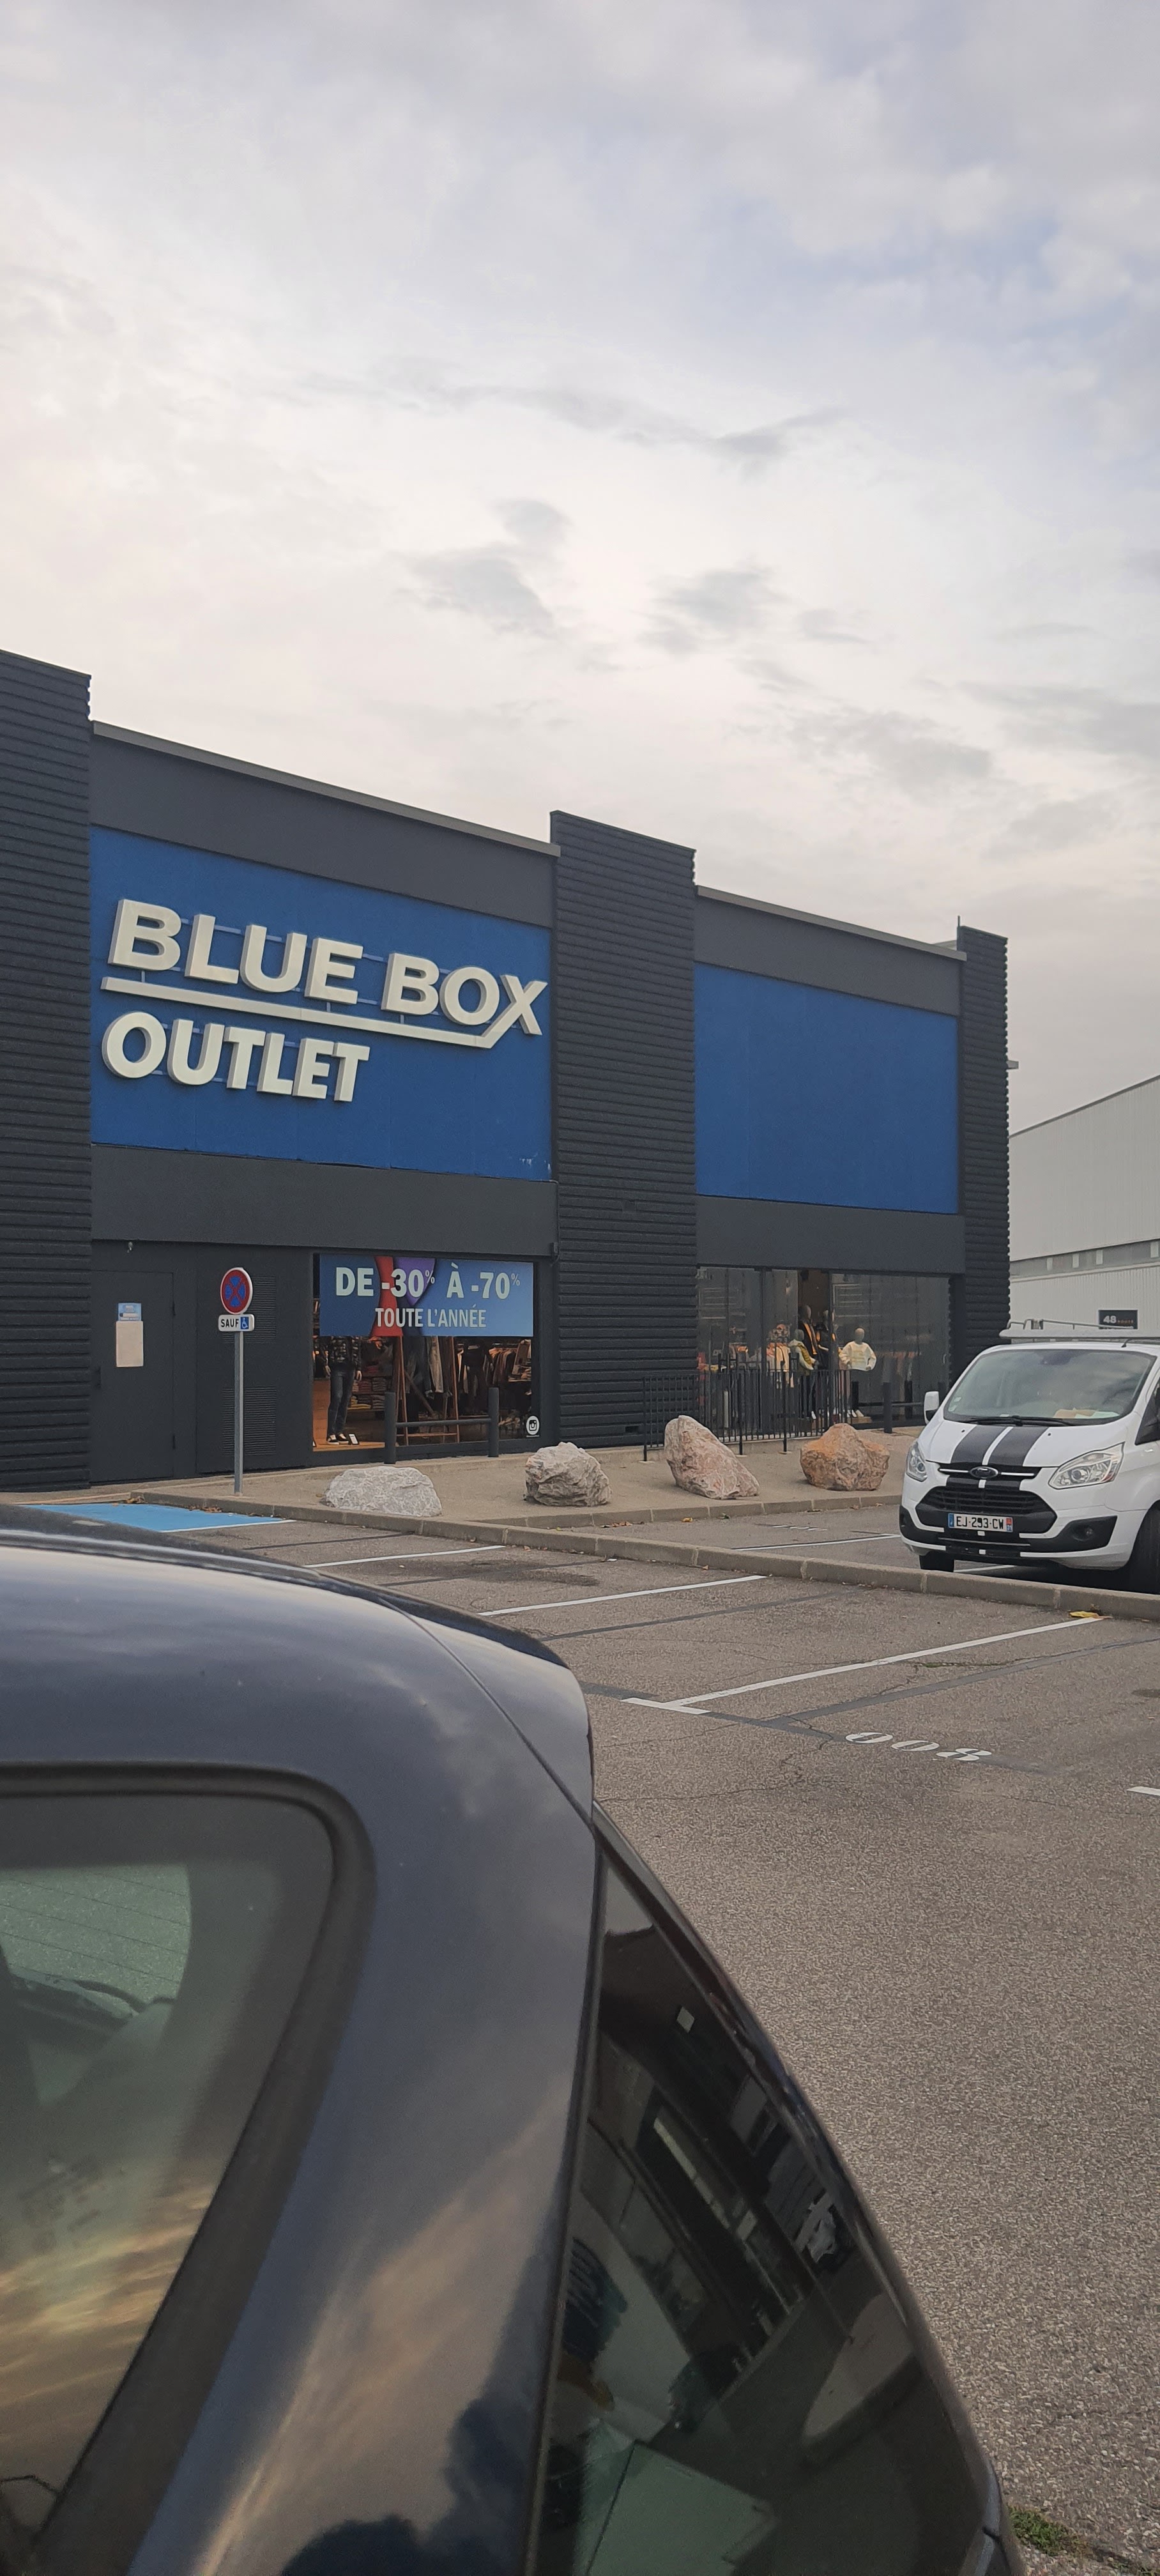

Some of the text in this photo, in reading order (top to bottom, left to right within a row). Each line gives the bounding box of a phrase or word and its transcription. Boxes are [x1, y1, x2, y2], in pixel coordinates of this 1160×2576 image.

[107, 898, 548, 1035] BLUE BOX
[102, 1011, 370, 1102] OUTLET
[336, 1262, 521, 1300] DE -30% À -70%
[220, 1319, 239, 1328] SAUF
[375, 1303, 486, 1328] TOUTE L'ANNÉE
[1103, 1315, 1117, 1324] 48
[956, 1516, 1004, 1529] EJ-293-CW
[844, 1732, 992, 1761] 008
